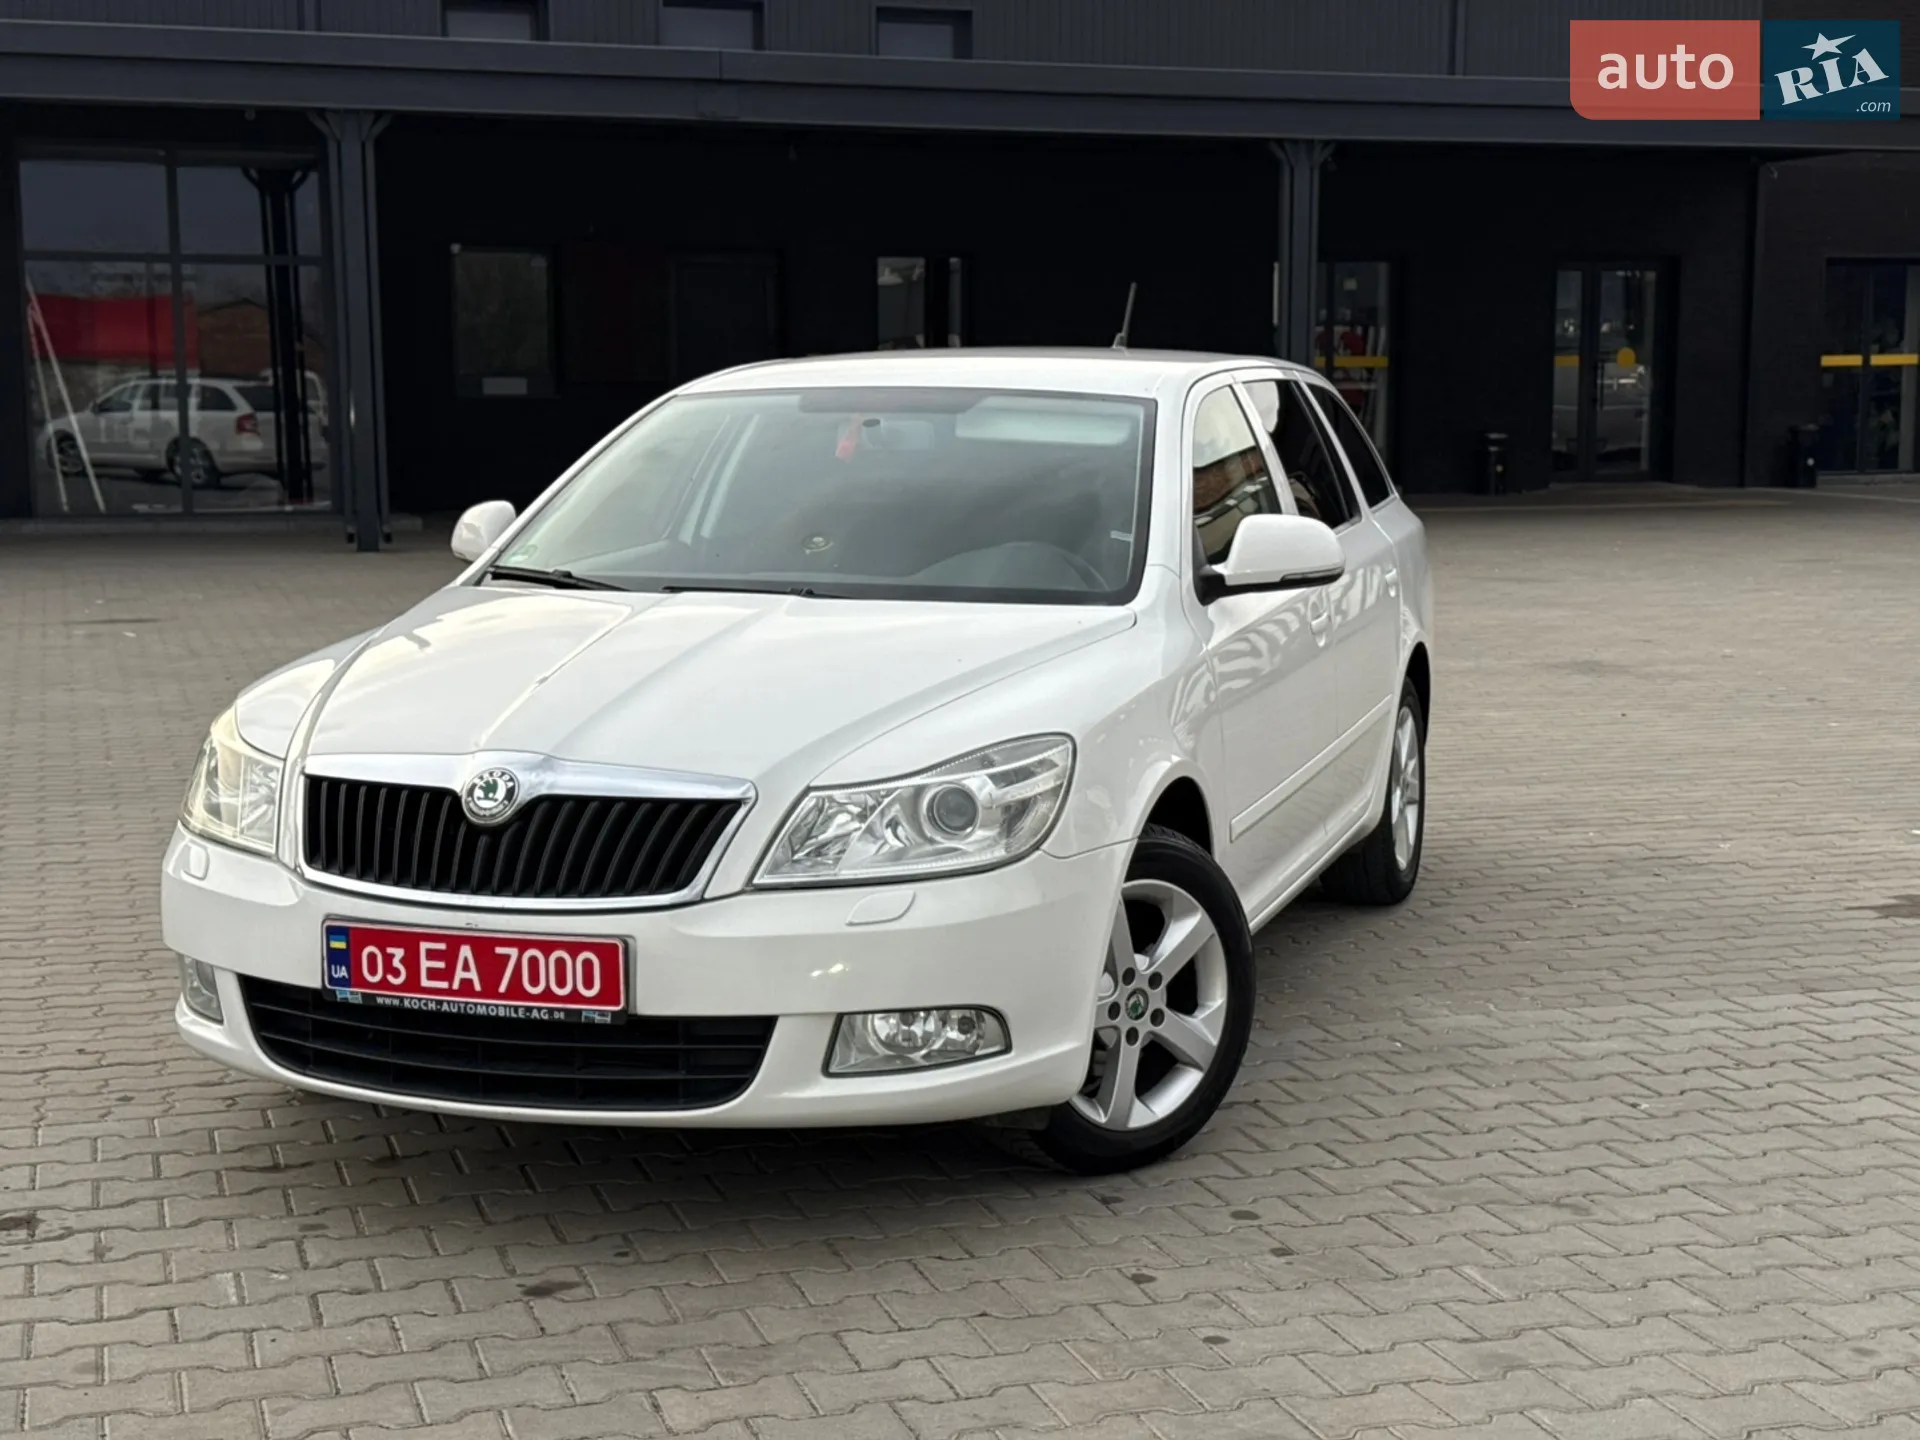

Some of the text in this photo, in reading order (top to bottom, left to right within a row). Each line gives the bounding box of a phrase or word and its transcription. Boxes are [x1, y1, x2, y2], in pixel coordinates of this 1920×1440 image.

[331, 965, 348, 979] UA
[361, 941, 600, 998] 03 EA 7000
